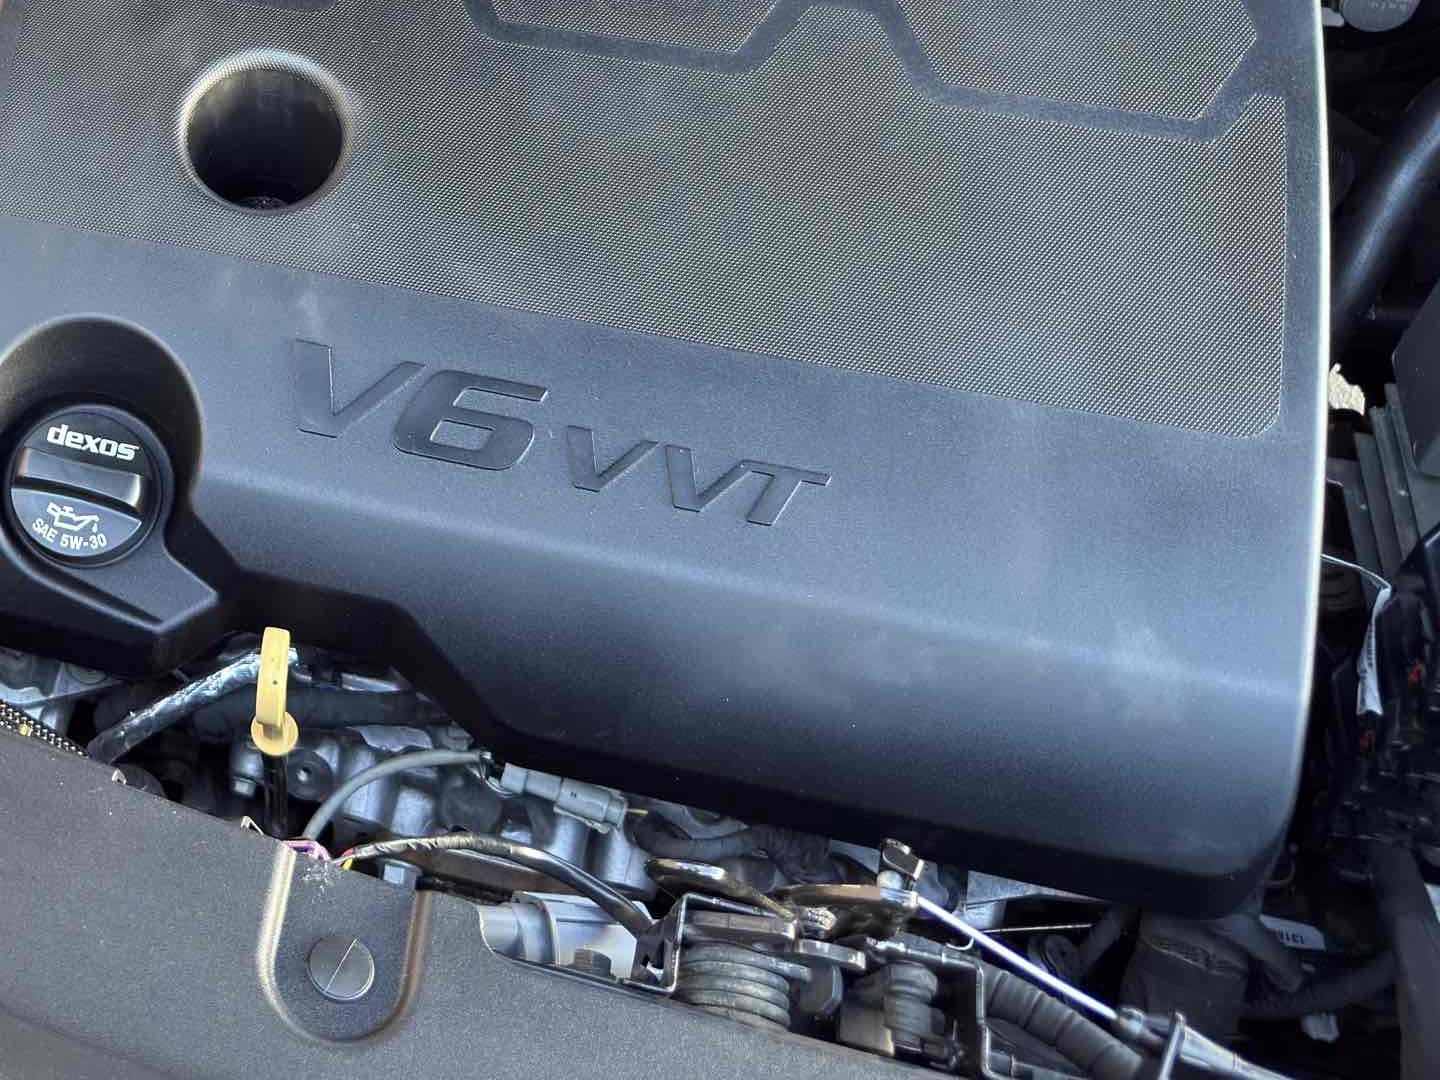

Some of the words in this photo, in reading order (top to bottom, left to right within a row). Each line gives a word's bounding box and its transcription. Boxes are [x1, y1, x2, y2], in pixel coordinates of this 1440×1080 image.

[46, 423, 140, 461] dexos
[291, 339, 548, 471] V6
[565, 424, 832, 526] VVT
[32, 518, 58, 543] SAE
[60, 532, 108, 551] 5W-30
